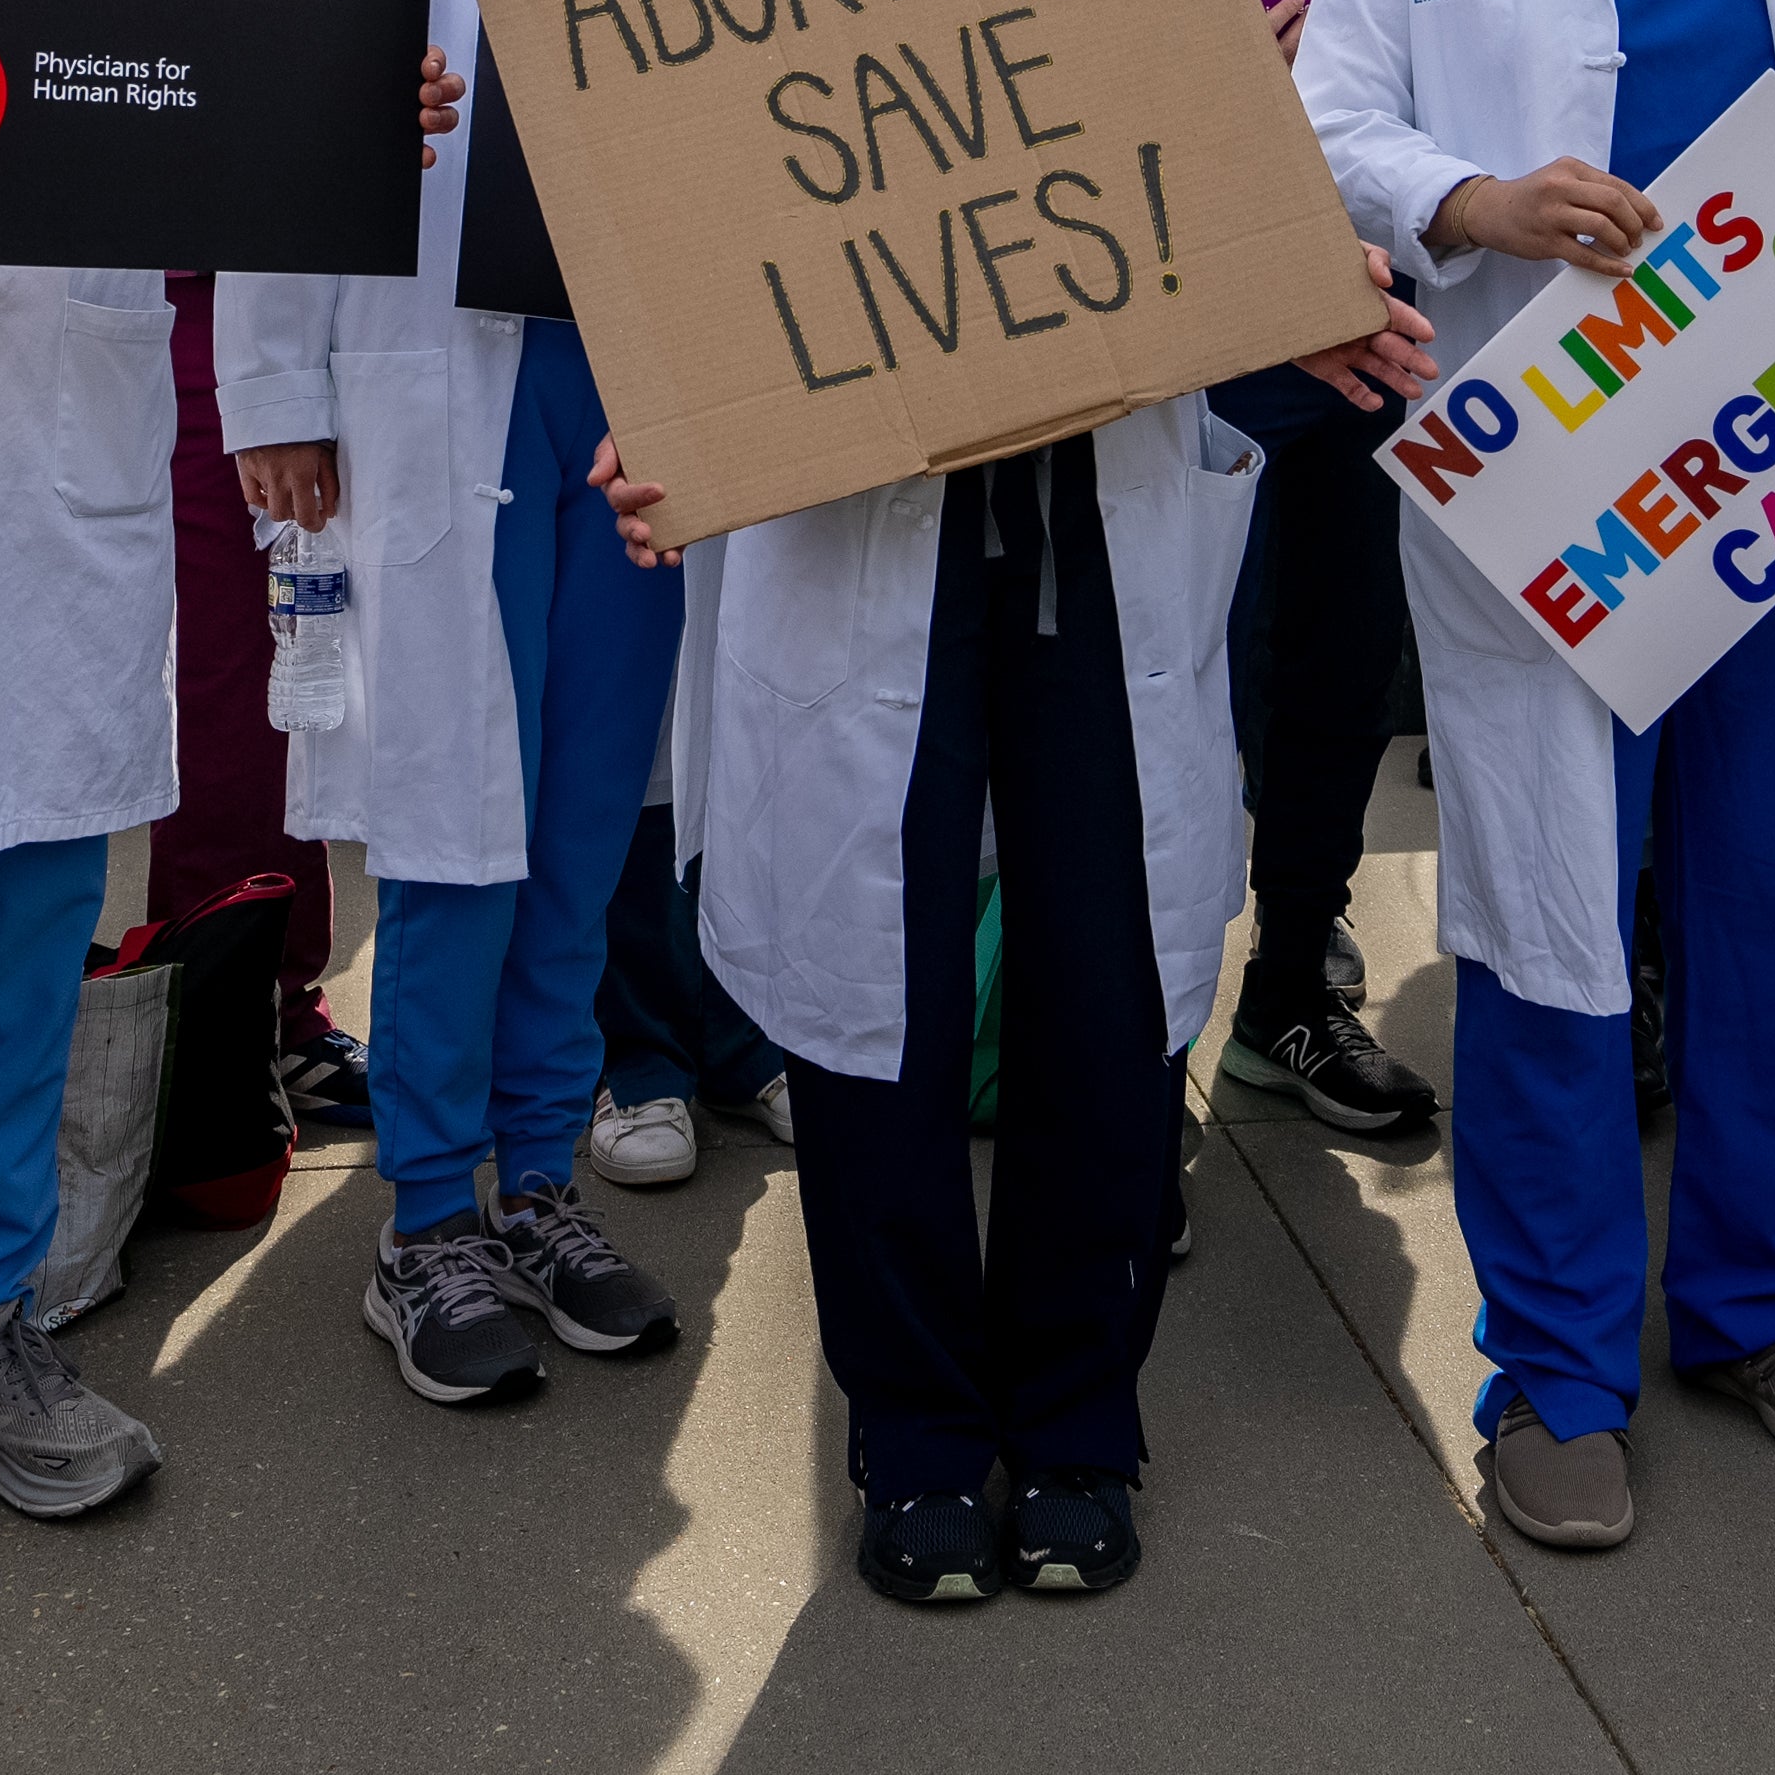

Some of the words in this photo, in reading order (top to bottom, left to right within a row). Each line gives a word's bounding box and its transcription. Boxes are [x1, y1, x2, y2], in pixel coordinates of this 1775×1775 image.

[33, 80, 119, 105] Human
[125, 82, 197, 111] Rights
[35, 52, 151, 81] Physicians
[155, 55, 191, 81] for
[766, 7, 1085, 206] SAVE
[761, 142, 1182, 394] LIVES!
[1391, 378, 1518, 506] NO
[1519, 191, 1764, 434] LIMITS
